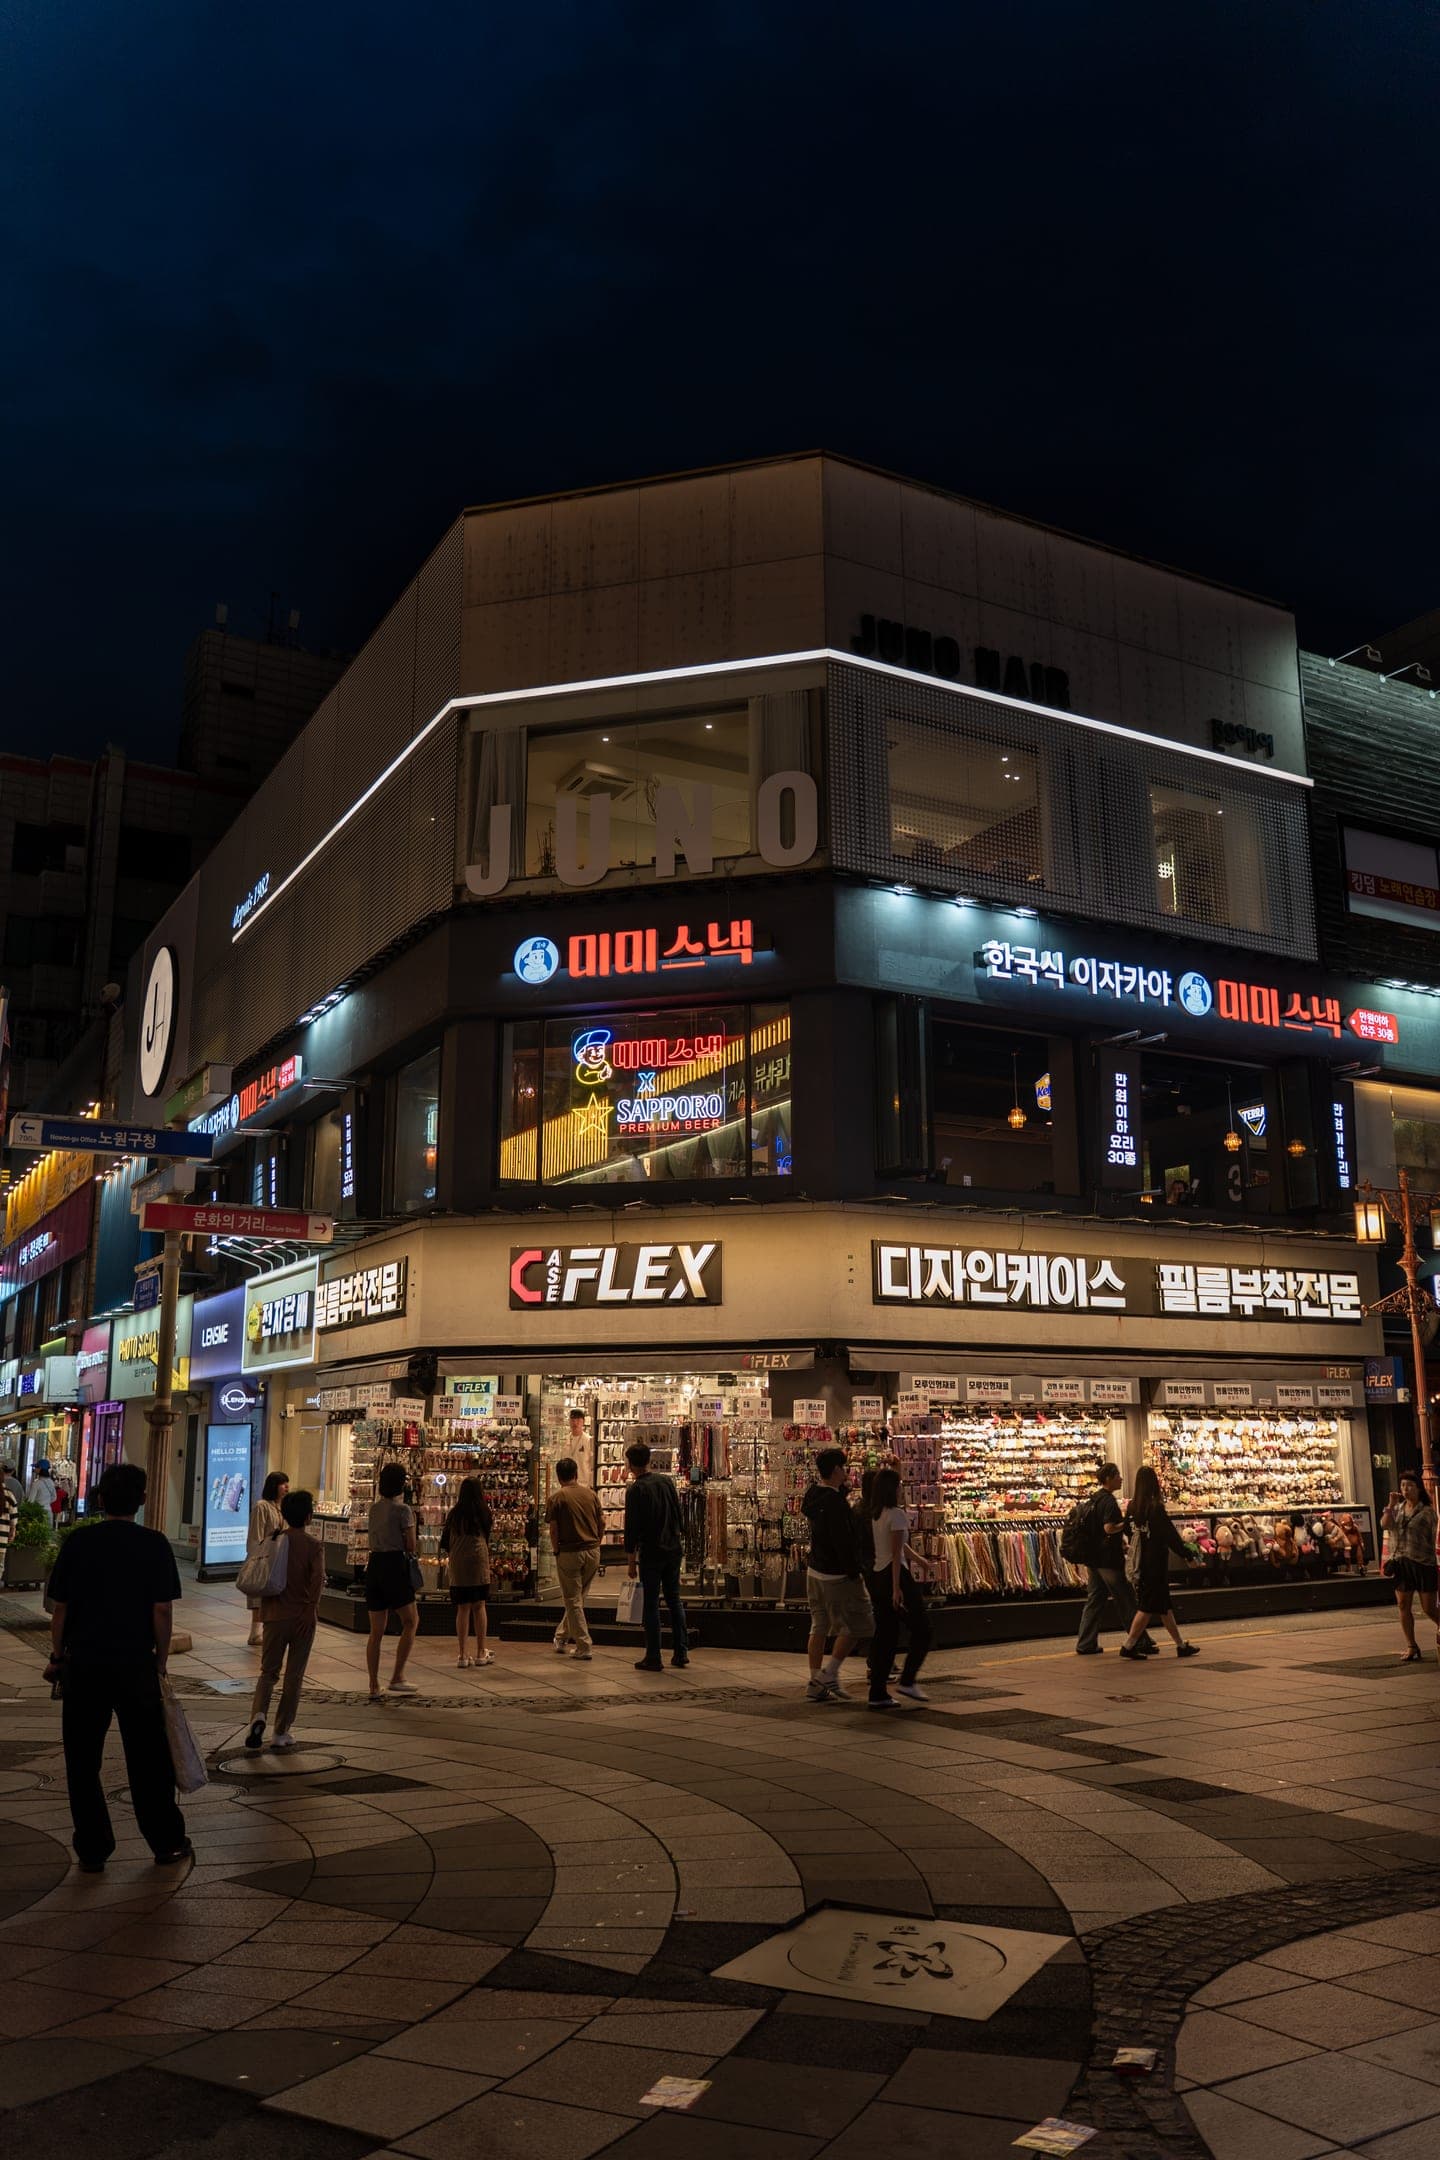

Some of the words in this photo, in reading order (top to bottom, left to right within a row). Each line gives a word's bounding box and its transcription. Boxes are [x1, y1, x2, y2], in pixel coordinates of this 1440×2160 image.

[464, 769, 818, 896] JUNO
[568, 919, 753, 979] 미미스낵
[983, 940, 1064, 989] 한국식
[1070, 957, 1173, 1007] 이자카야
[1217, 979, 1341, 1038] 미미스낵
[613, 1035, 723, 1069] 미미스낵
[240, 1066, 276, 1121] 미미스낵
[617, 1094, 722, 1123] SAPPORO
[98, 1131, 156, 1149] 노원구청
[619, 1121, 680, 1133] PREMIUM
[685, 1118, 721, 1130] BEER
[1110, 1134, 1134, 1150] 요리
[1107, 1151, 1136, 1165] 30종
[193, 1211, 235, 1230] 문화의
[238, 1215, 265, 1231] 거리
[878, 1246, 1126, 1308] 디자인케이스
[1157, 1264, 1361, 1318] 필름부착전문
[119, 1336, 138, 1361] PHOTO
[138, 1326, 160, 1358] SIGNA
[201, 1323, 229, 1347] LENSME
[461, 1407, 487, 1416] 름부착
